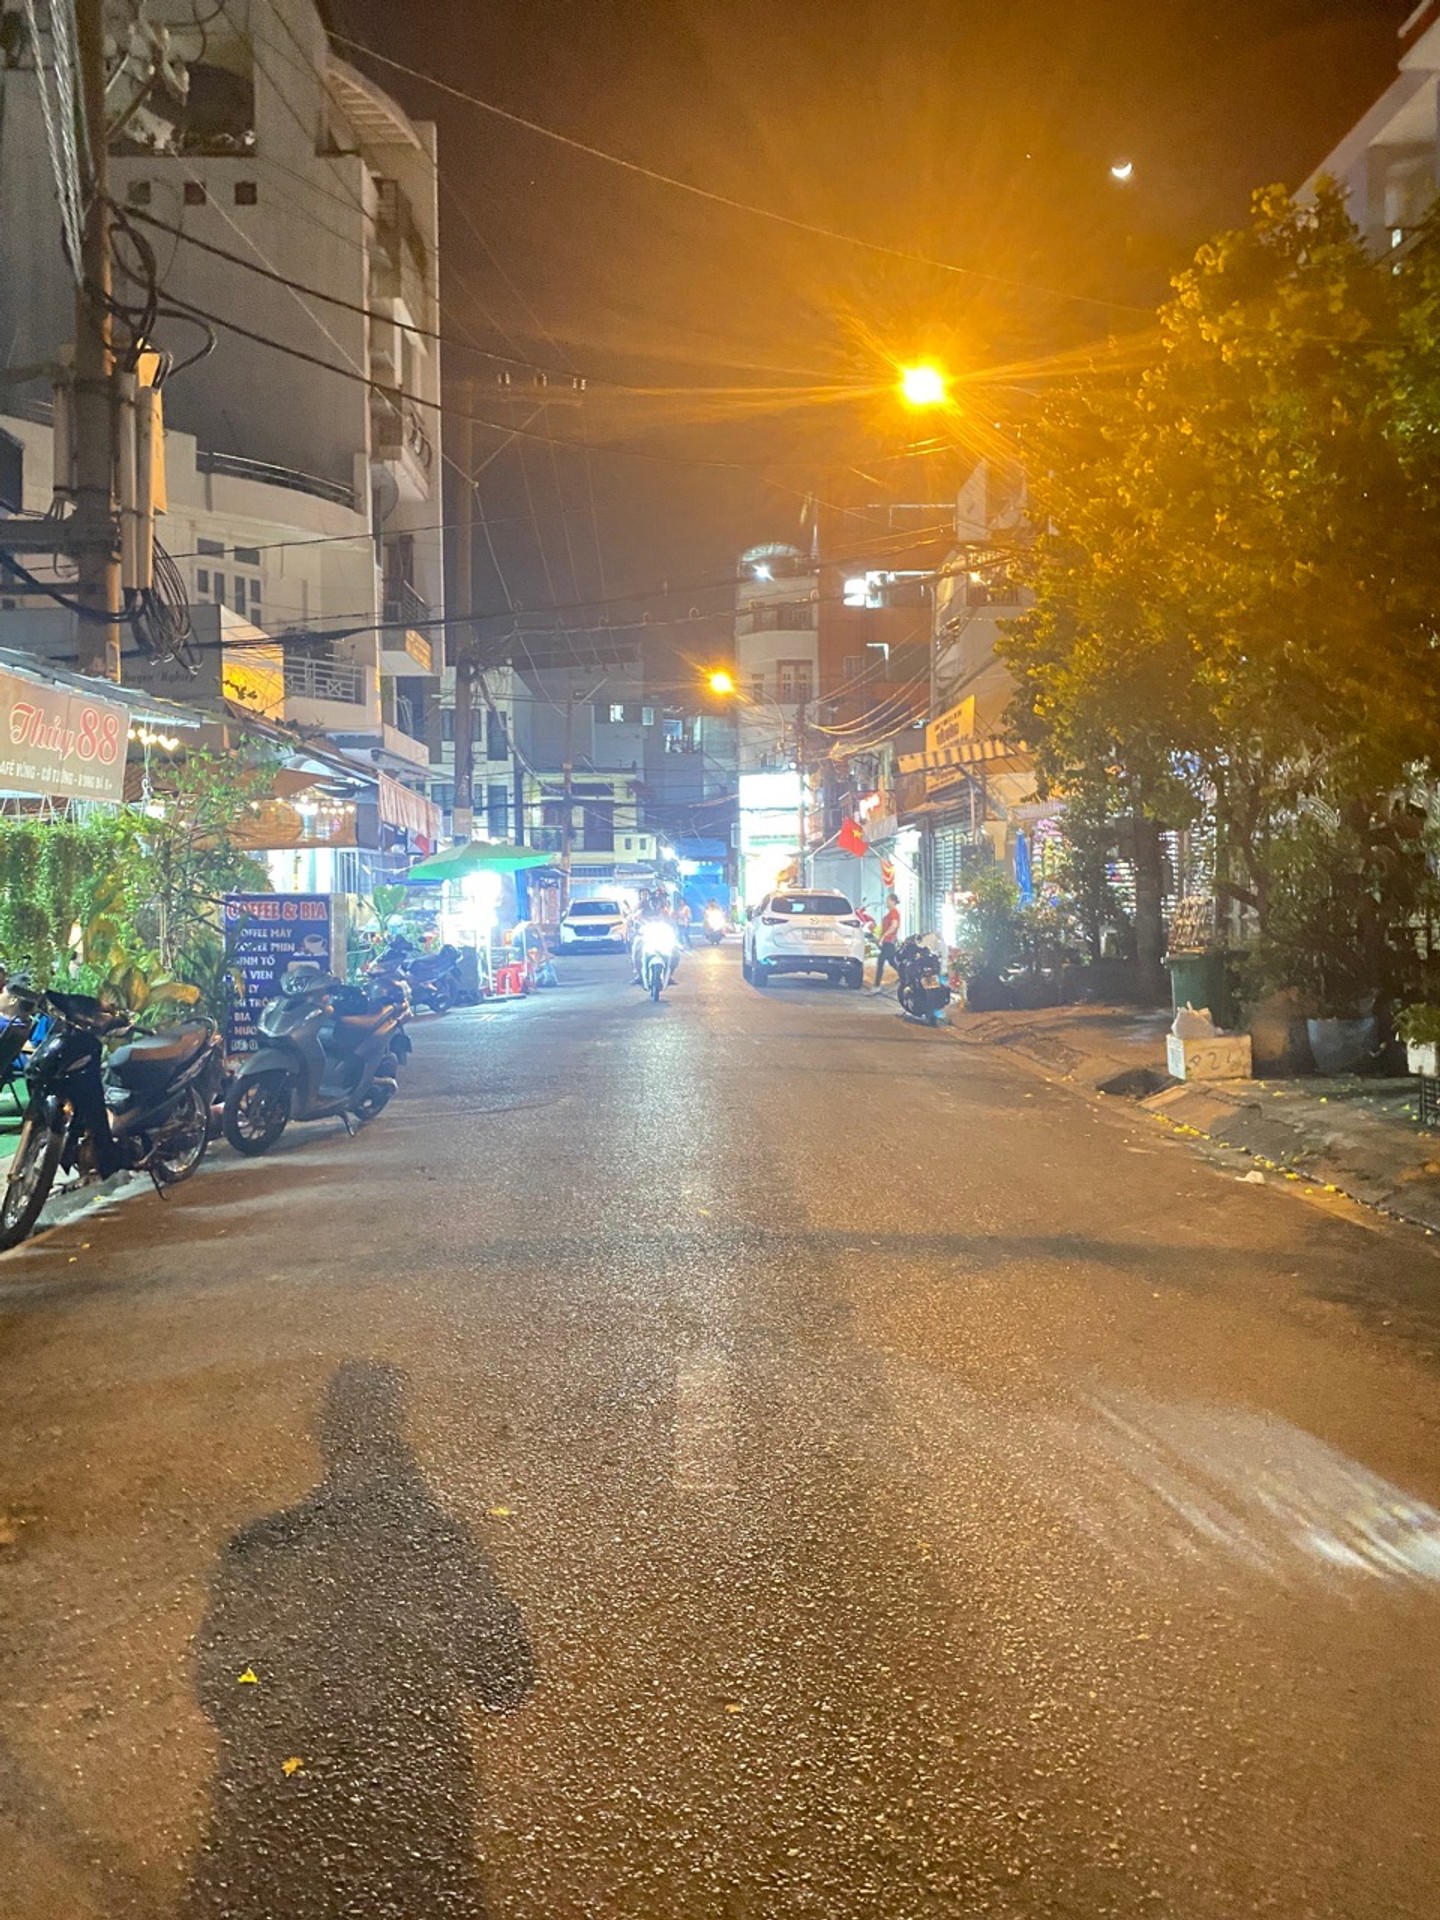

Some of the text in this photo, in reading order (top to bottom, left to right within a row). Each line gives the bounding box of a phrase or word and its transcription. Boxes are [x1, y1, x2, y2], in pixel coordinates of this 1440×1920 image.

[9, 702, 120, 765] Thủy 88
[282, 901, 297, 921] &
[300, 901, 328, 920] BIA
[240, 928, 268, 938] OFFEE
[234, 1012, 251, 1022] BIA
